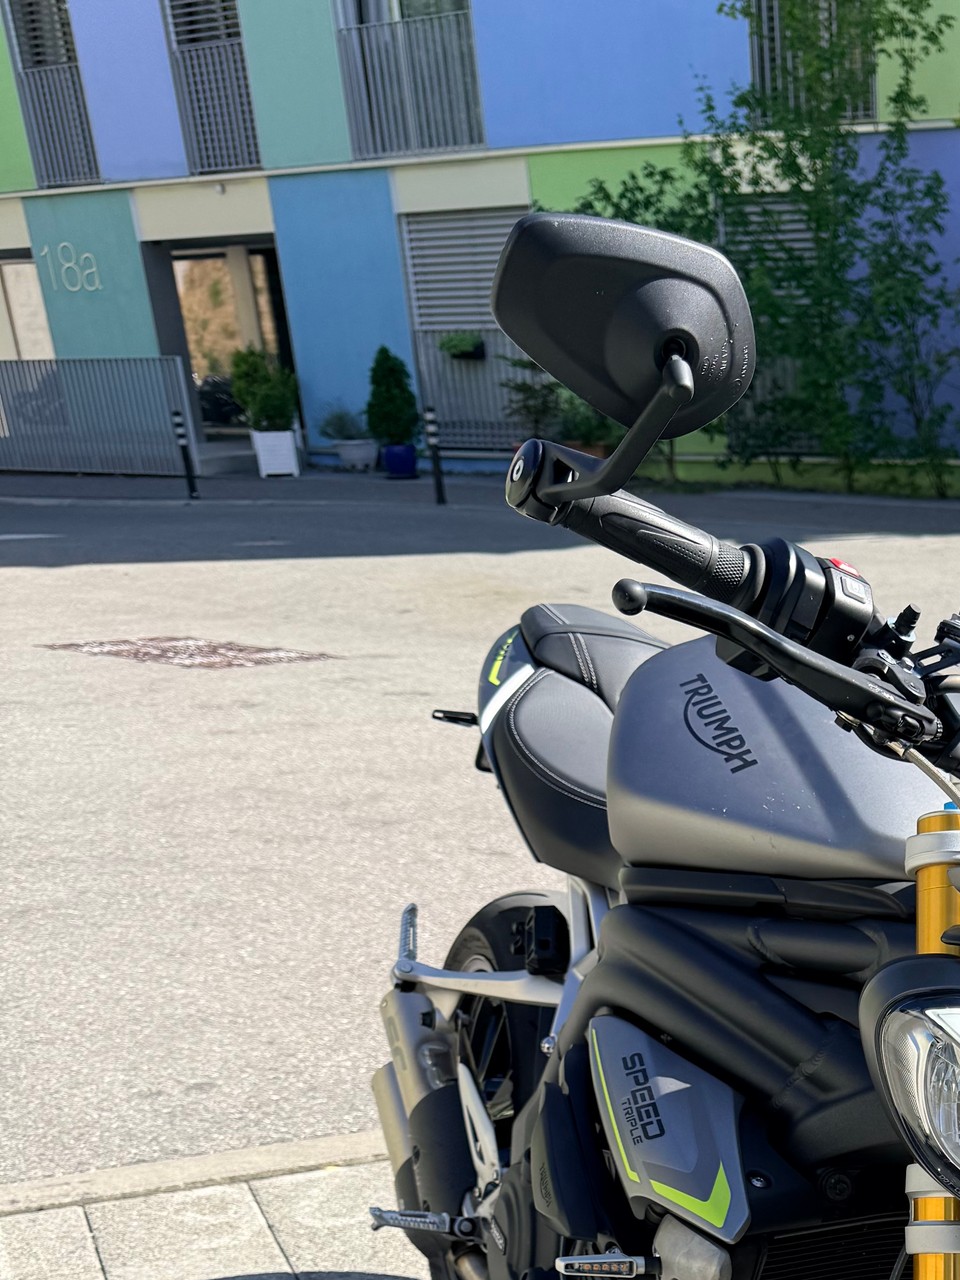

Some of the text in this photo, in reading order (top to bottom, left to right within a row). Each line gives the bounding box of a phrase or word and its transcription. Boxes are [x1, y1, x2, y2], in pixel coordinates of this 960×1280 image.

[40, 242, 104, 292] 18a
[679, 673, 759, 775] TRIUMPH
[621, 1052, 666, 1141] SPEED
[621, 1097, 643, 1146] TRIPLE
